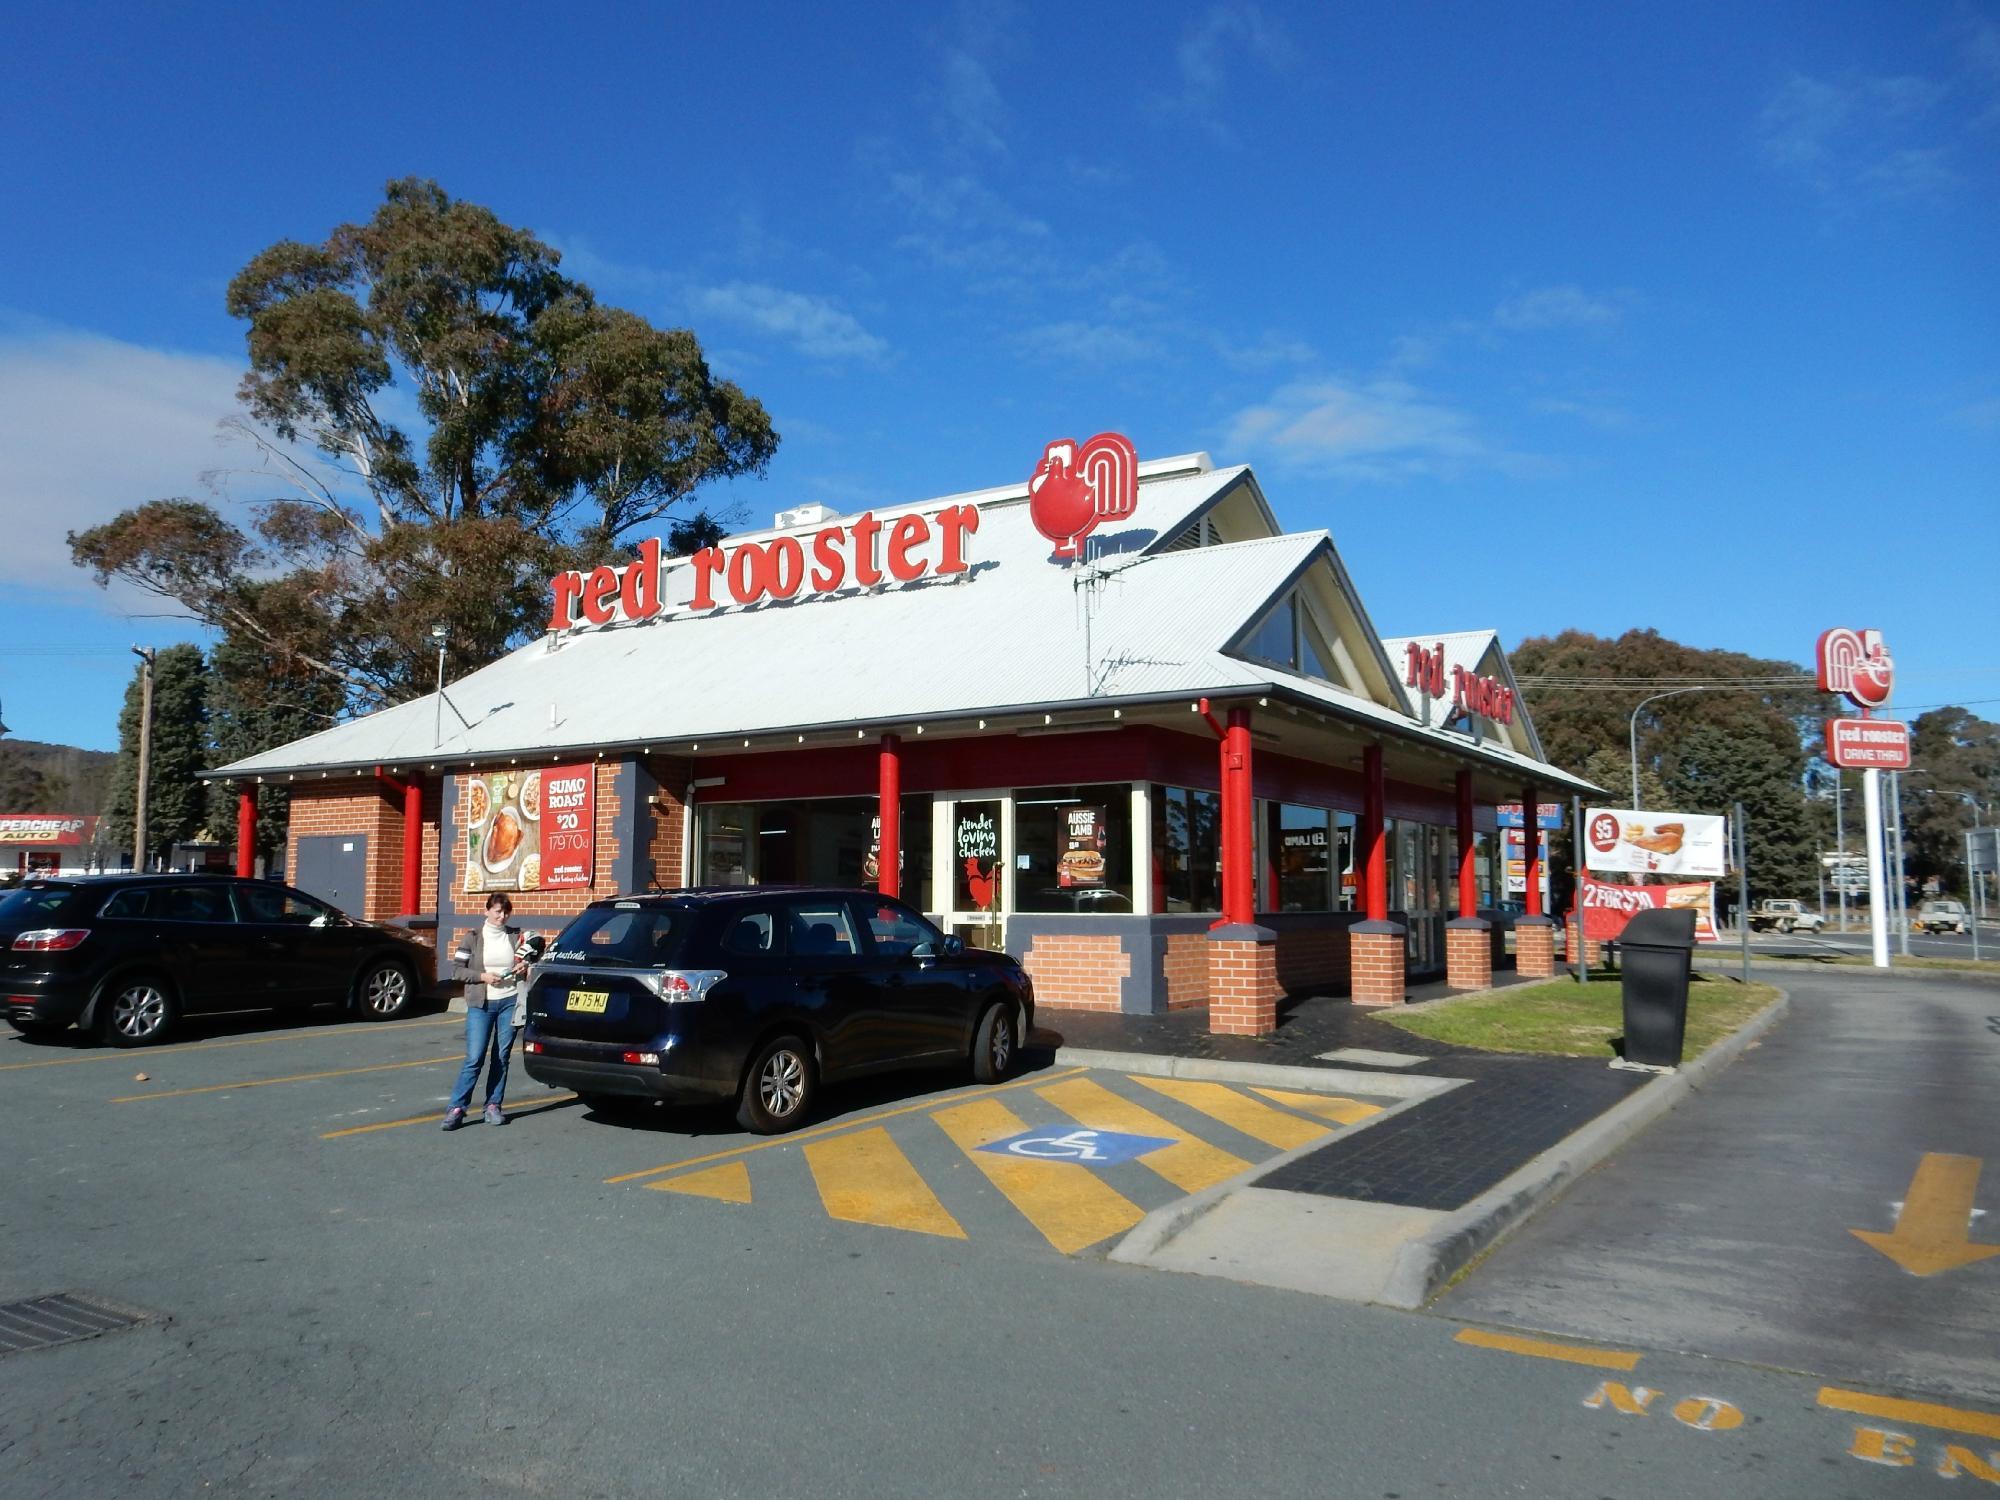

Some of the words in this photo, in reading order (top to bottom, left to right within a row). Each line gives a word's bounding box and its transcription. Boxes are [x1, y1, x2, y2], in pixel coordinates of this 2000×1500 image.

[548, 537, 662, 630] red
[690, 504, 981, 612] rooster
[1839, 727, 1860, 742] red
[1844, 748, 1875, 760] DRIVE
[1876, 750, 1904, 761] THRU
[549, 778, 585, 793] SUMO
[549, 793, 586, 809] ROAST
[0, 819, 84, 832] PERCHEAP
[557, 813, 578, 829] $20
[962, 813, 993, 831] tender
[1067, 812, 1095, 825] AUSSIE
[4, 832, 51, 840] AUTO
[1070, 824, 1093, 836] LAMB
[1595, 819, 1613, 840] $5
[958, 827, 996, 848] loving
[958, 845, 996, 859] chicken
[1583, 884, 1596, 907] 2
[1596, 888, 1623, 910] FOR
[569, 993, 580, 1006] BW
[582, 993, 593, 1007] 75
[1583, 1381, 1745, 1430] NO
